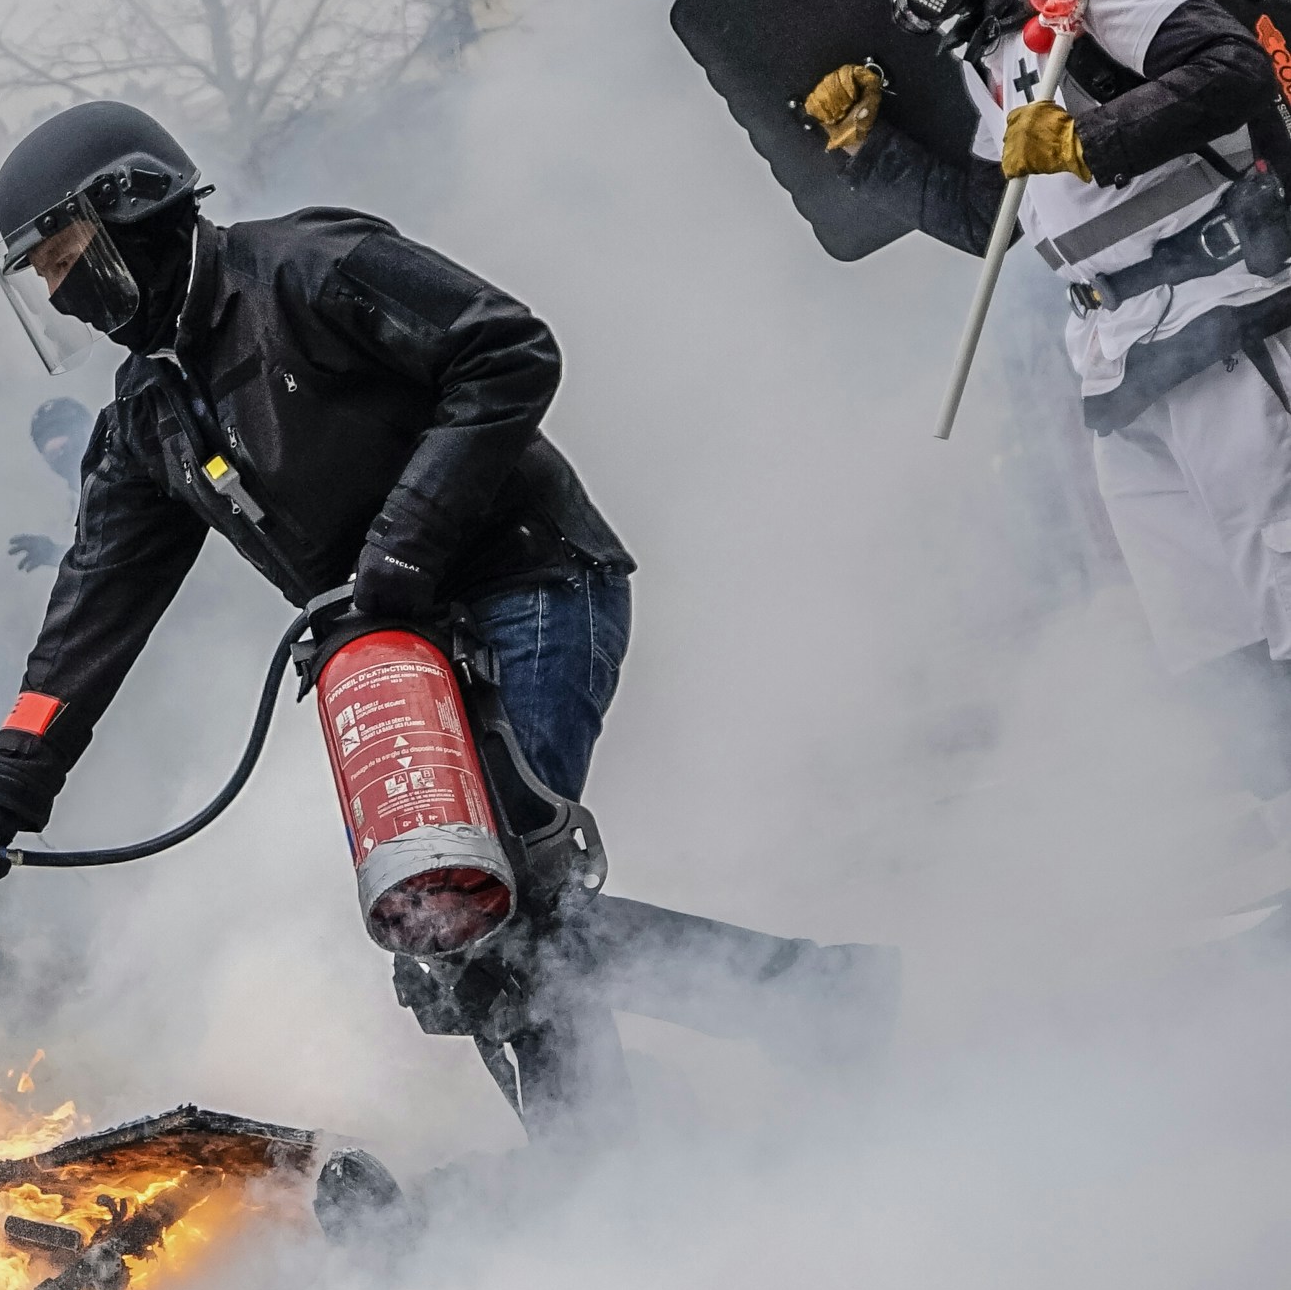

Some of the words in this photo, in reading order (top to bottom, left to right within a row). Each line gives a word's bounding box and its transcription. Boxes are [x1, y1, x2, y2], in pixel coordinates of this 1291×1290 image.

[384, 555, 420, 572] FORCLAZ
[329, 678, 358, 704] APPAREIL
[358, 664, 415, 682] D'EXTINCTION
[415, 665, 446, 679] DORSAL
[397, 775, 405, 784] A
[423, 770, 431, 778] B
